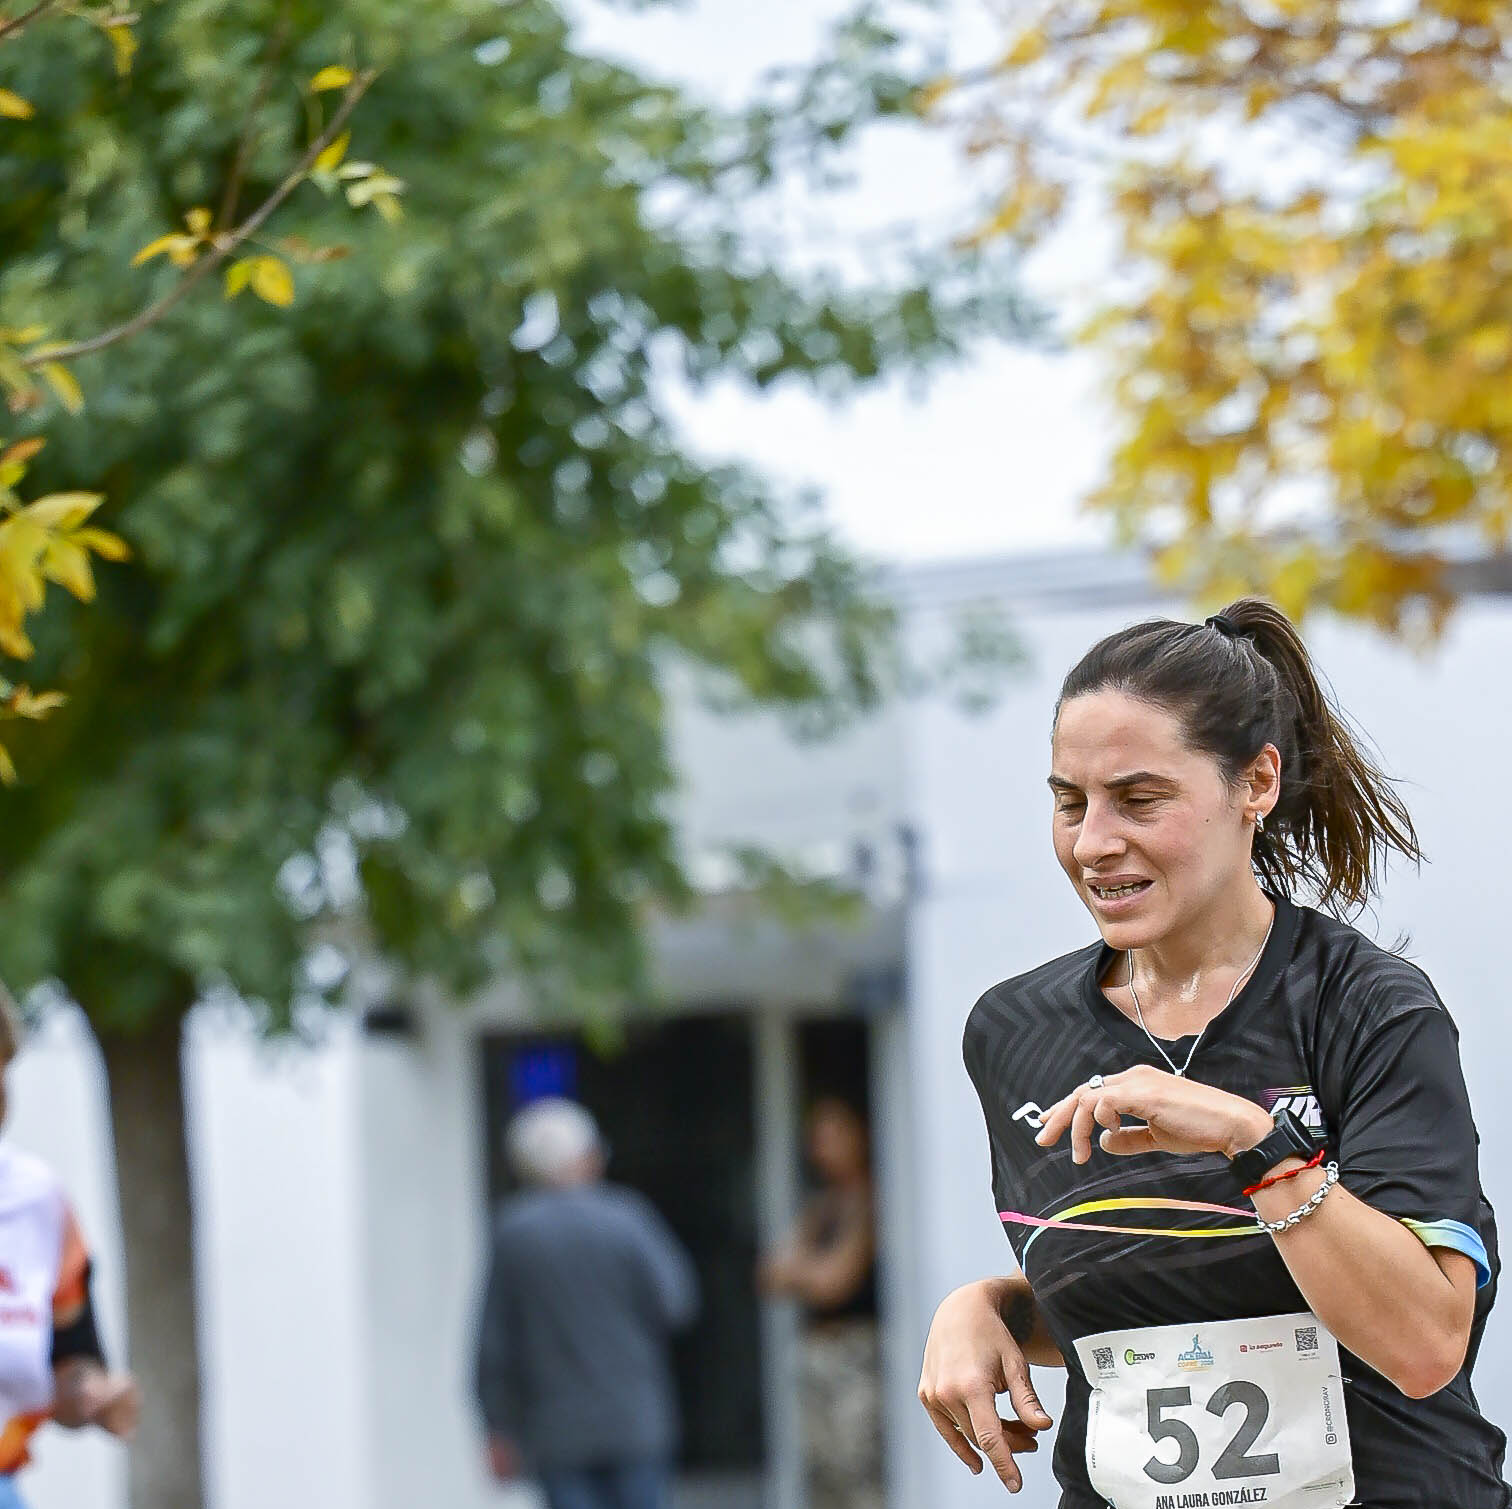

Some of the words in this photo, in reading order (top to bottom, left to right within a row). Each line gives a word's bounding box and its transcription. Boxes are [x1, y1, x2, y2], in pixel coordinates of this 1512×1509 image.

[1142, 1380, 1281, 1484] 52
[1176, 1492, 1211, 1508] LAURA
[1211, 1486, 1268, 1506] GONZÁLEZ
